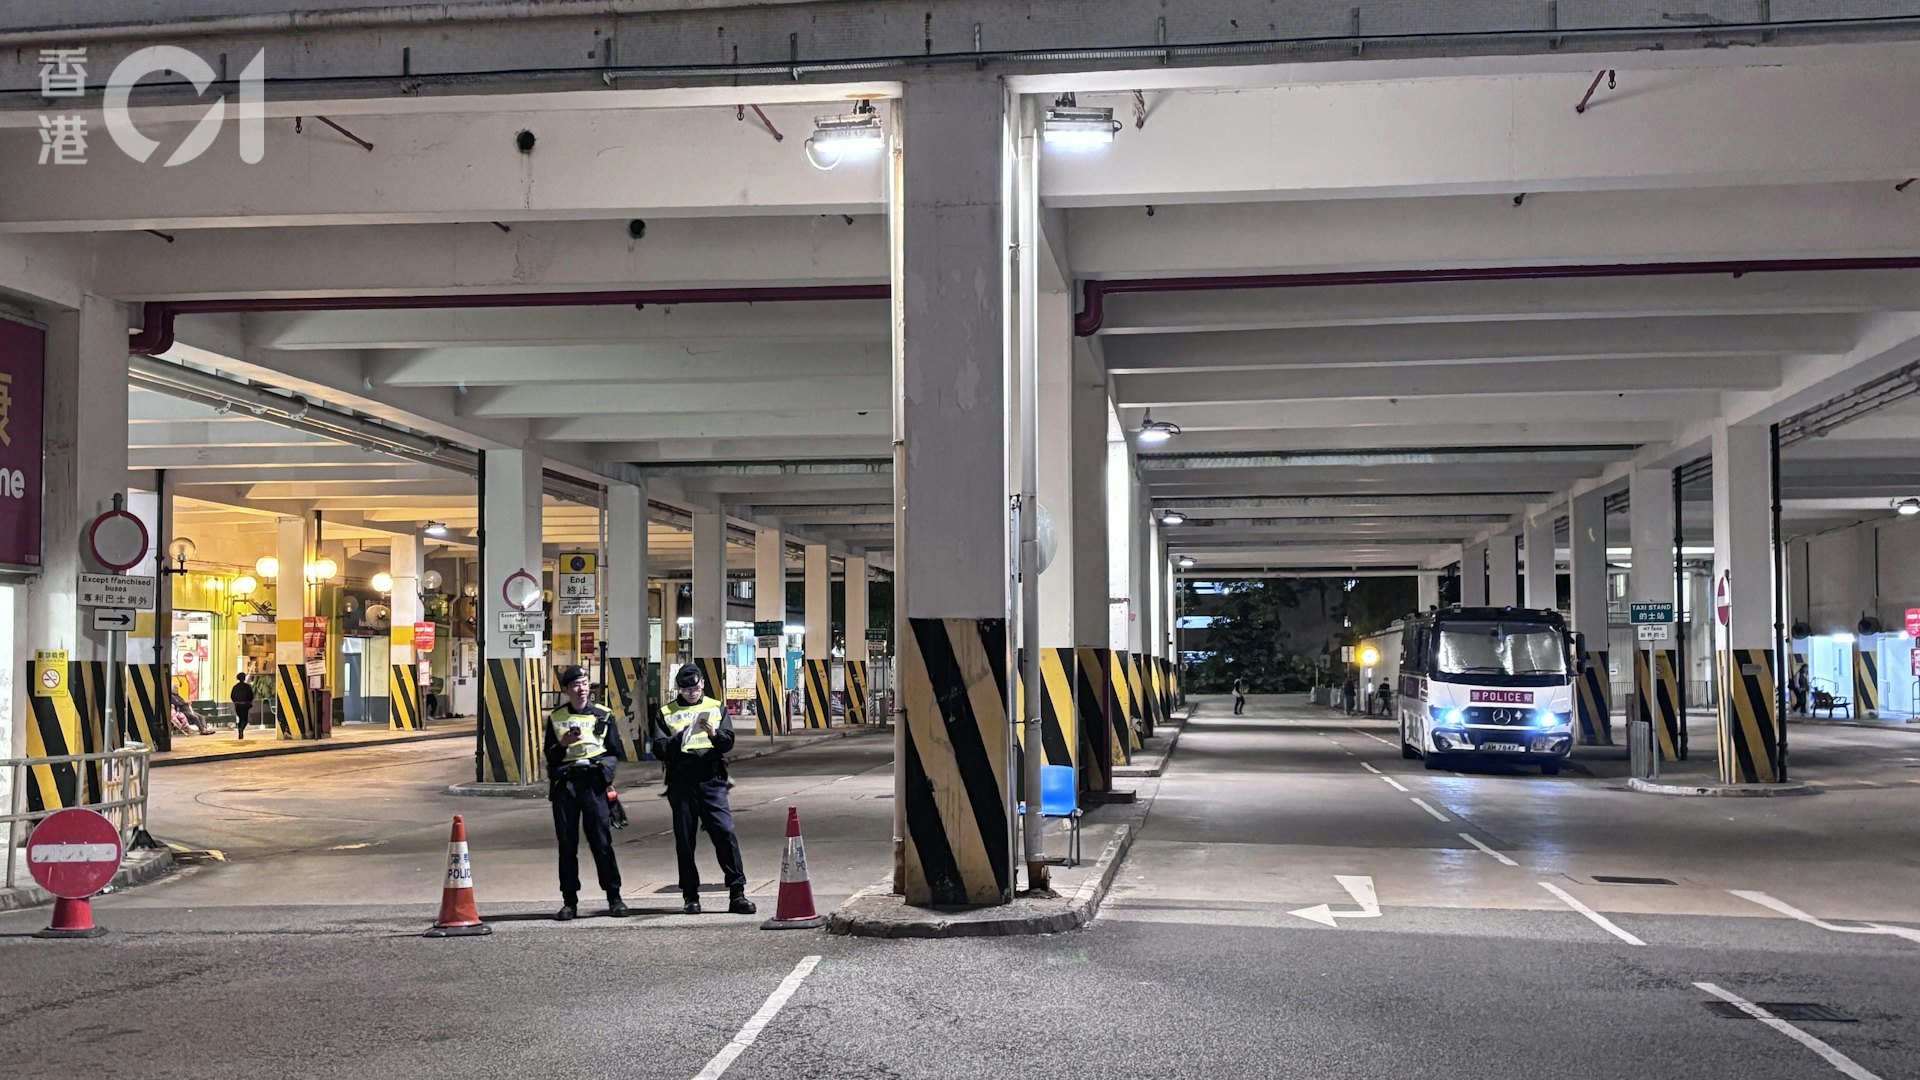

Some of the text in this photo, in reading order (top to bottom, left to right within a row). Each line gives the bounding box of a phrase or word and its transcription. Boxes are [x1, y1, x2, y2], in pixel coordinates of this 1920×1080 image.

[82, 575, 109, 584] Except
[570, 576, 586, 584] End
[567, 585, 589, 595] 終止
[84, 593, 147, 605] 專利巴士例外
[1639, 612, 1665, 620] 的士站
[1482, 691, 1521, 702] POLICE
